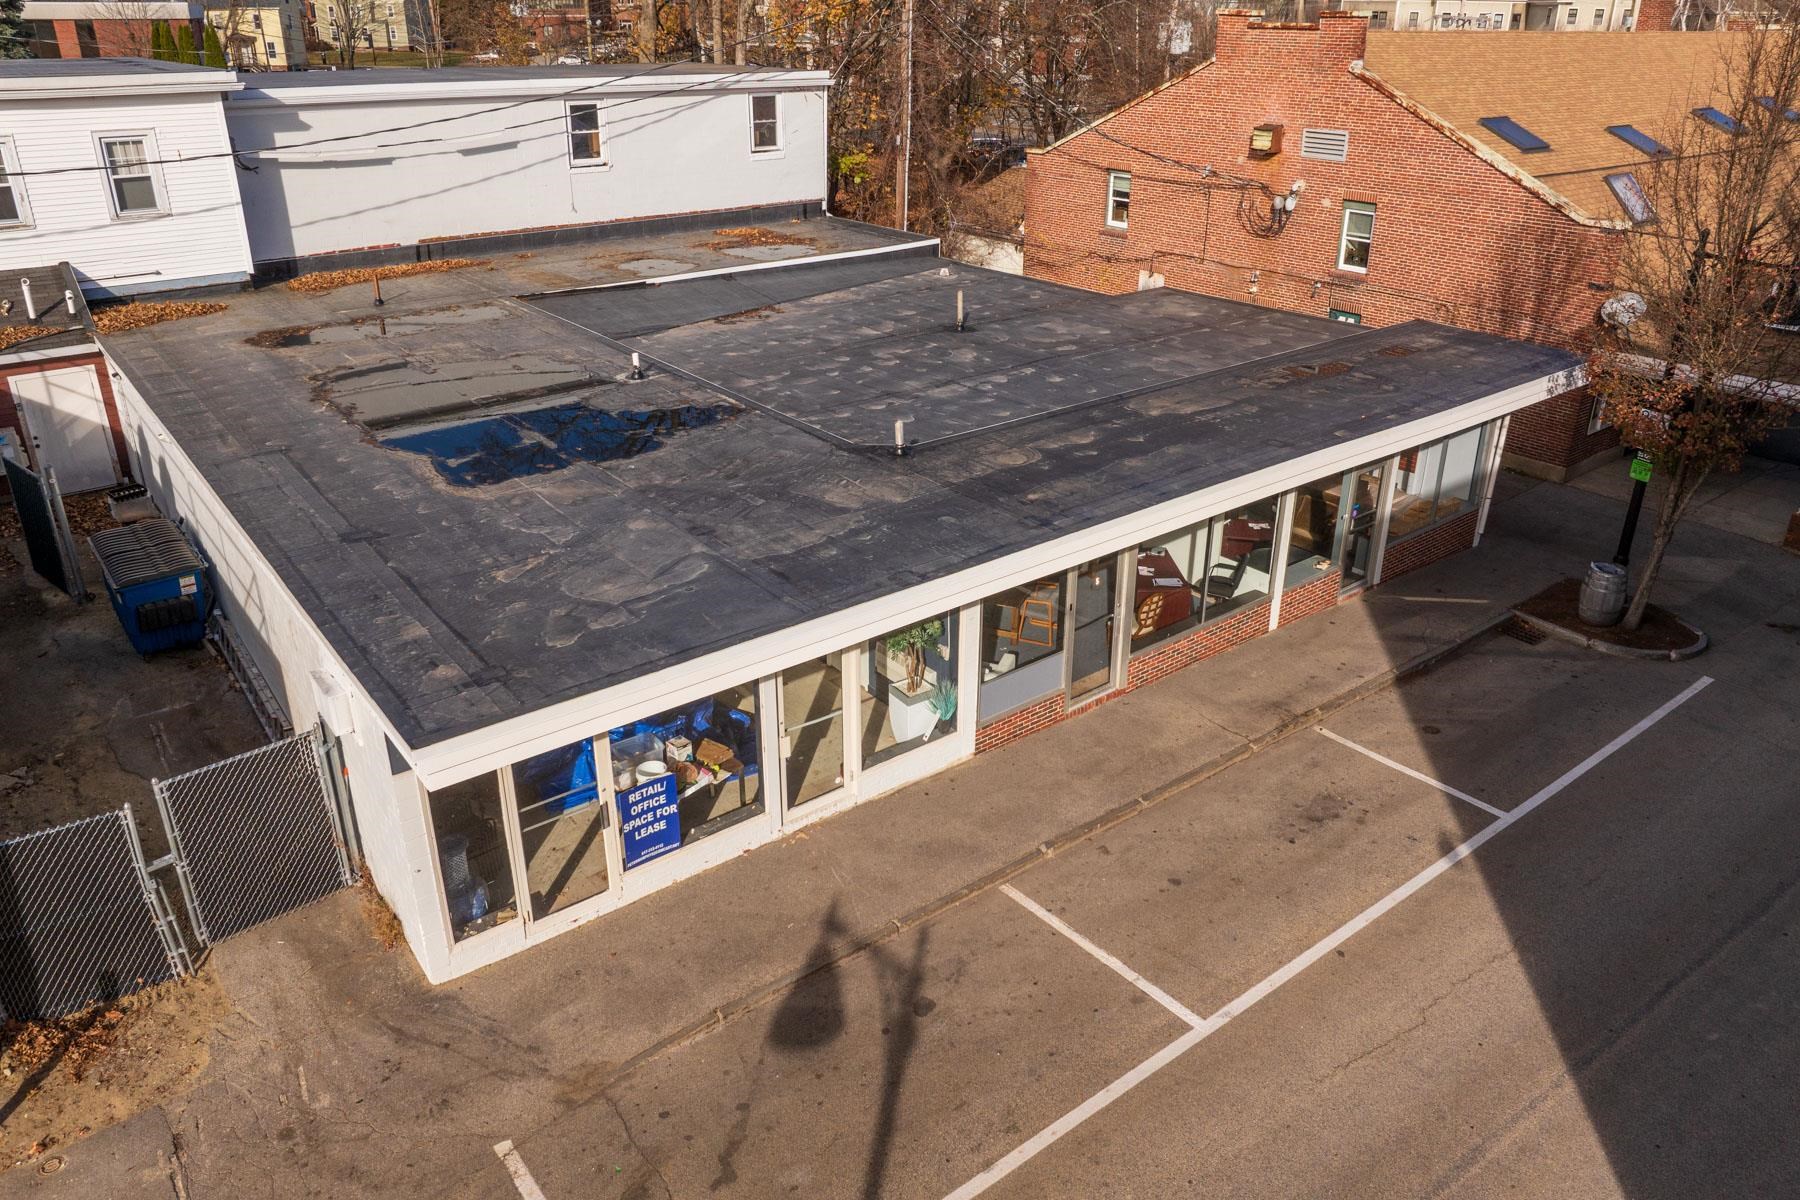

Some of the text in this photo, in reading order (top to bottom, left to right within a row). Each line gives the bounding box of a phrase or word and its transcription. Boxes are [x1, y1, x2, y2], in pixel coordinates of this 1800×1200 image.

[628, 781, 667, 804] RETAIL/
[631, 794, 667, 816] OFFICE
[623, 803, 678, 833] SPACE FOR
[635, 820, 667, 840] LEASE
